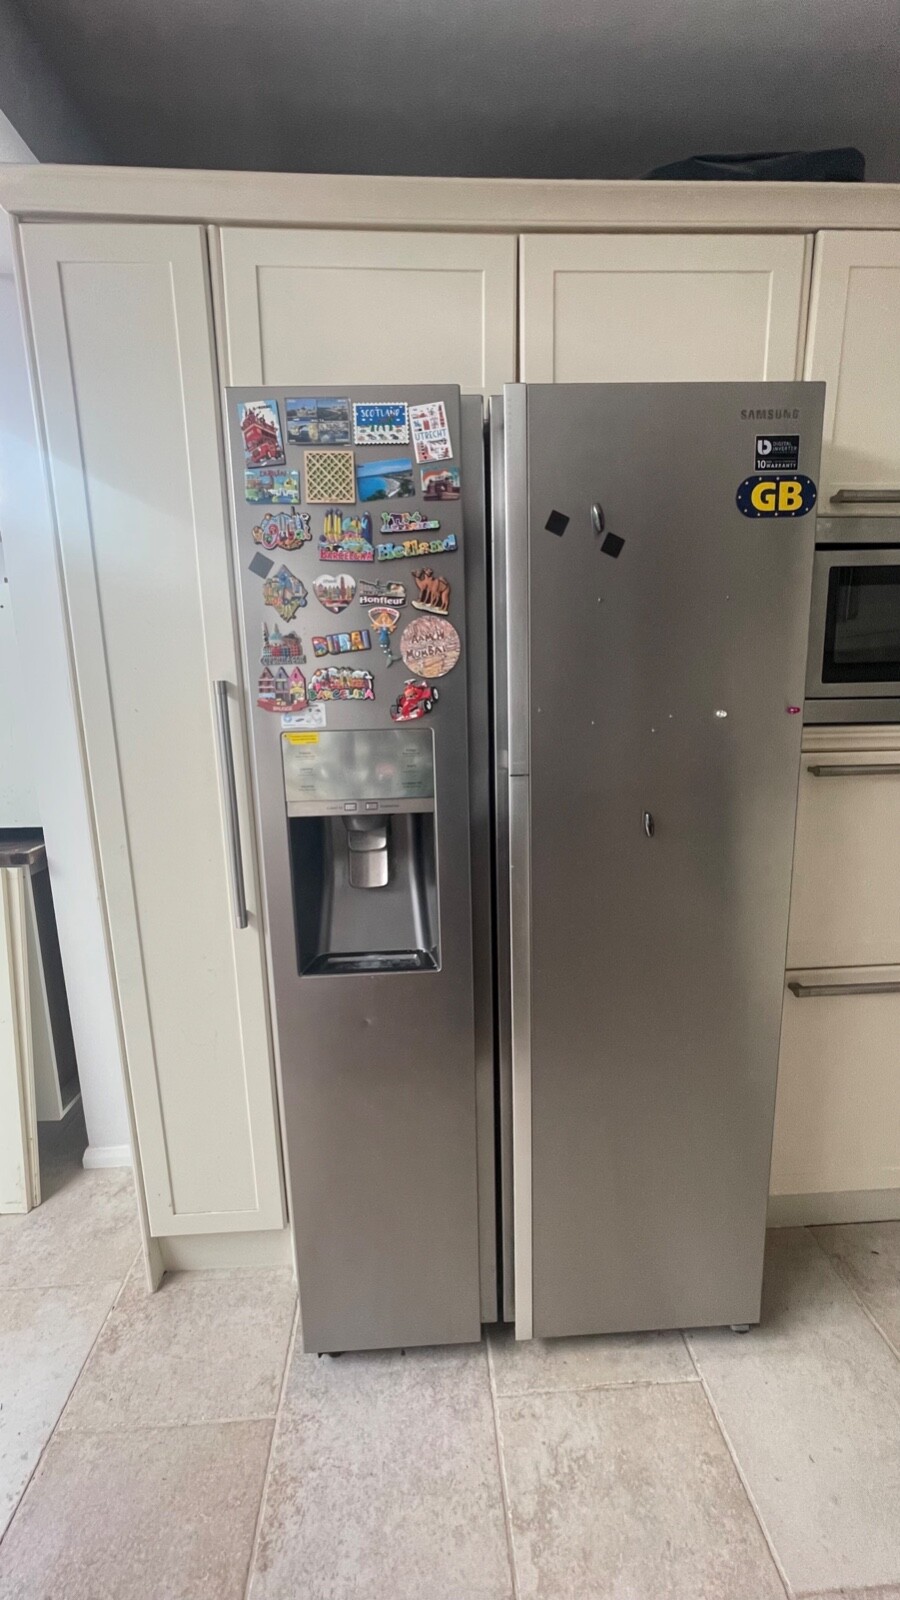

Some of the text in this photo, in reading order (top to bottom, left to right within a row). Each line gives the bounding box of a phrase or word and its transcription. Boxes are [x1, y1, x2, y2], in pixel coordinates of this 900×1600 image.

[360, 408, 400, 418] SCOTLAND
[740, 409, 800, 419] SAMSUNG
[414, 429, 447, 441] UTRECHT
[757, 460, 766, 469] 10
[751, 481, 803, 511] GB
[320, 549, 373, 560] BARCELONA
[360, 596, 405, 605] Honfleur
[312, 629, 372, 658] DUBAI
[307, 687, 375, 701] BARCELONA
